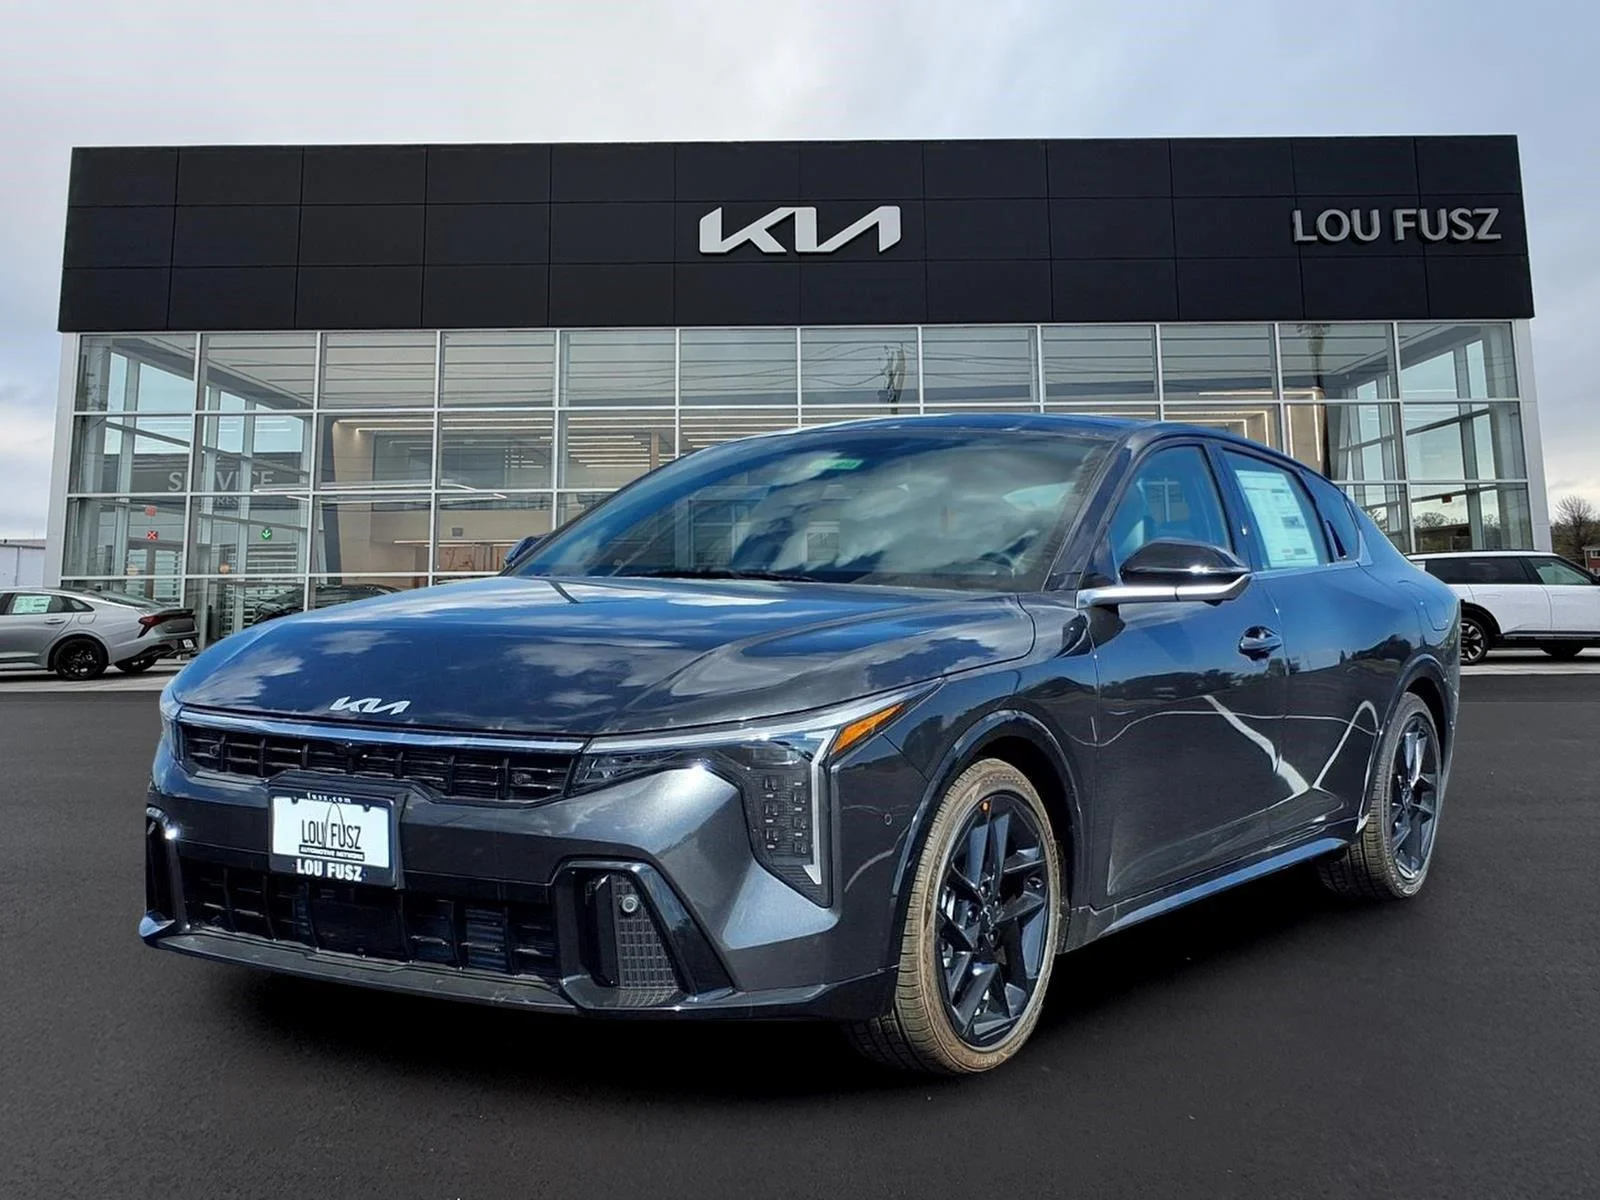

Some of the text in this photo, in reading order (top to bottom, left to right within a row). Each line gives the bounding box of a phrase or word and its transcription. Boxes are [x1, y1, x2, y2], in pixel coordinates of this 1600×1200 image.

[699, 205, 902, 253] KIA
[1292, 207, 1502, 242] LOU FUSZ
[167, 471, 274, 492] SVIE
[329, 696, 411, 715] KIA
[301, 819, 362, 849] LOU FUSZ
[296, 858, 363, 881] LOU FUSZ
